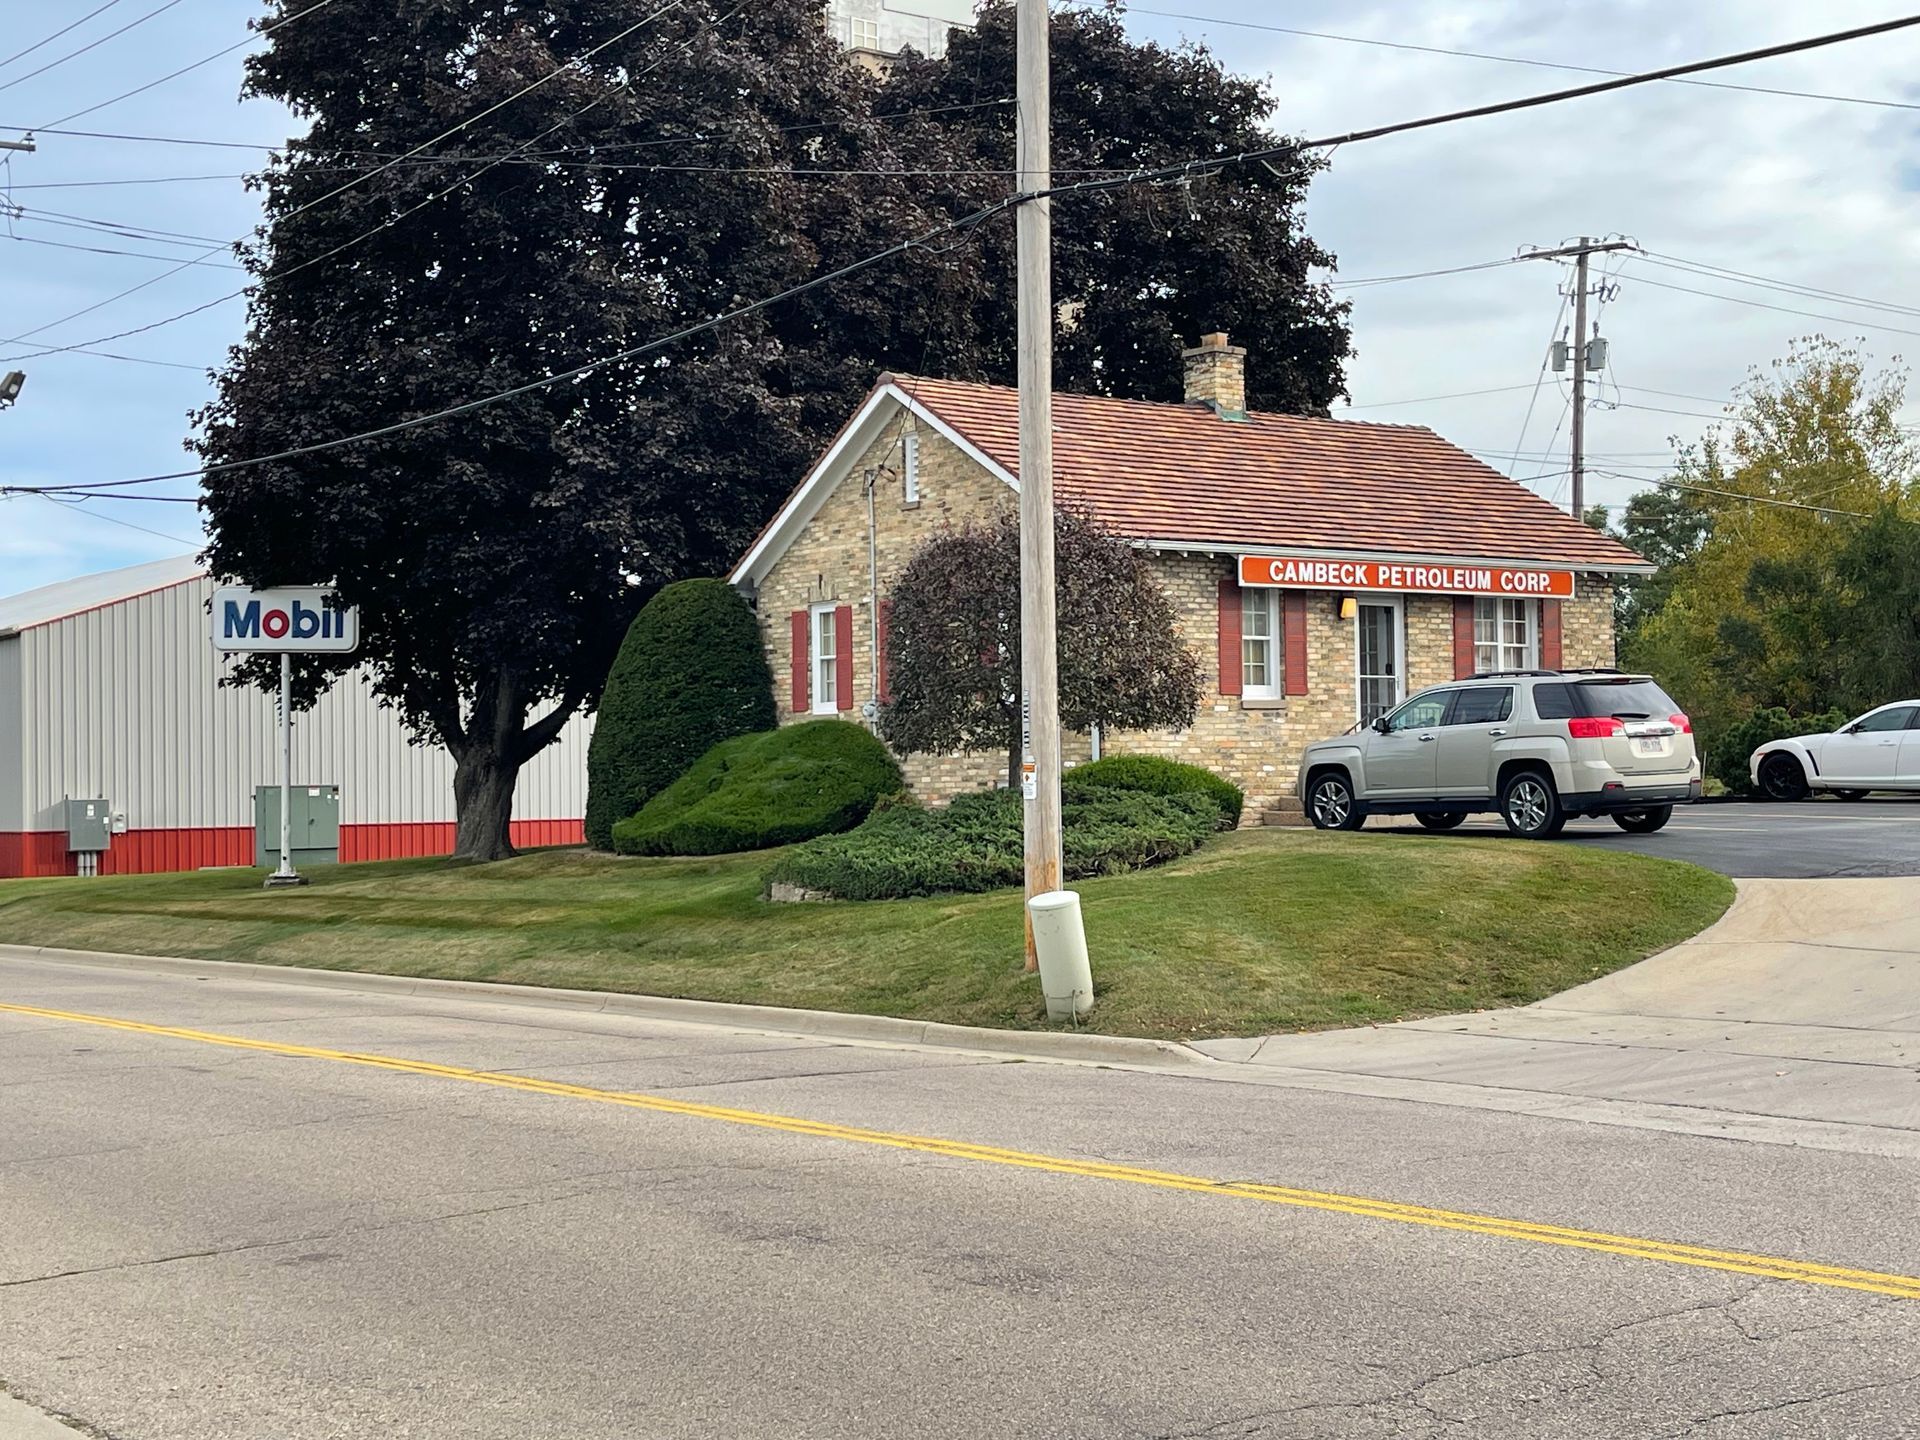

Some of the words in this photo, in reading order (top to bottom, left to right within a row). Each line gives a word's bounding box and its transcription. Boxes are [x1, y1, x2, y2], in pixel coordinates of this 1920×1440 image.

[1269, 560, 1368, 585] CAMBECK
[1378, 565, 1492, 590] PETROLEUM
[1500, 571, 1552, 592] CORP.
[223, 600, 344, 639] Mobil
